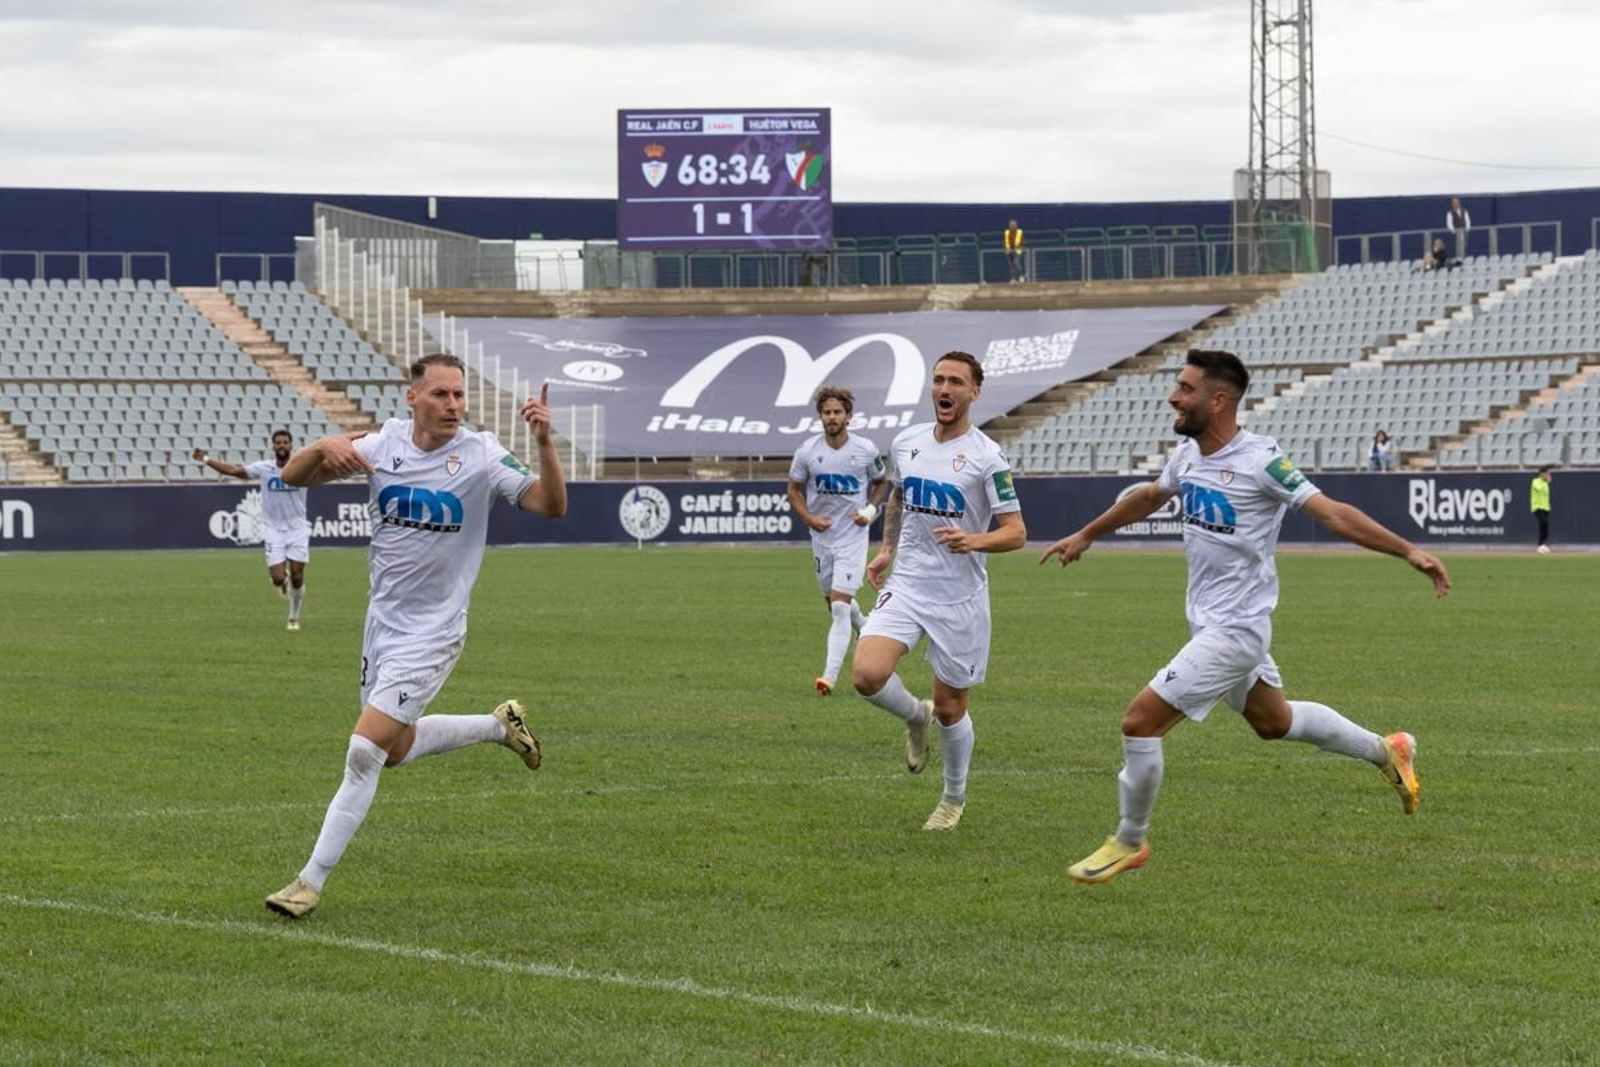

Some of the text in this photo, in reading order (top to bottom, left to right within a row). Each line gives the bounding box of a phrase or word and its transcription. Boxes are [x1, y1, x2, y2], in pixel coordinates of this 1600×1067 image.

[626, 120, 653, 130] REAL
[656, 119, 682, 130] JAÉN
[791, 120, 818, 130] VEGA
[677, 154, 771, 185] 68:34
[693, 203, 704, 234] 1
[741, 203, 752, 234] 1
[646, 413, 771, 434] ¡Hala
[680, 490, 791, 513] CAFÉ 100%
[679, 512, 792, 534] JAENÉRICO
